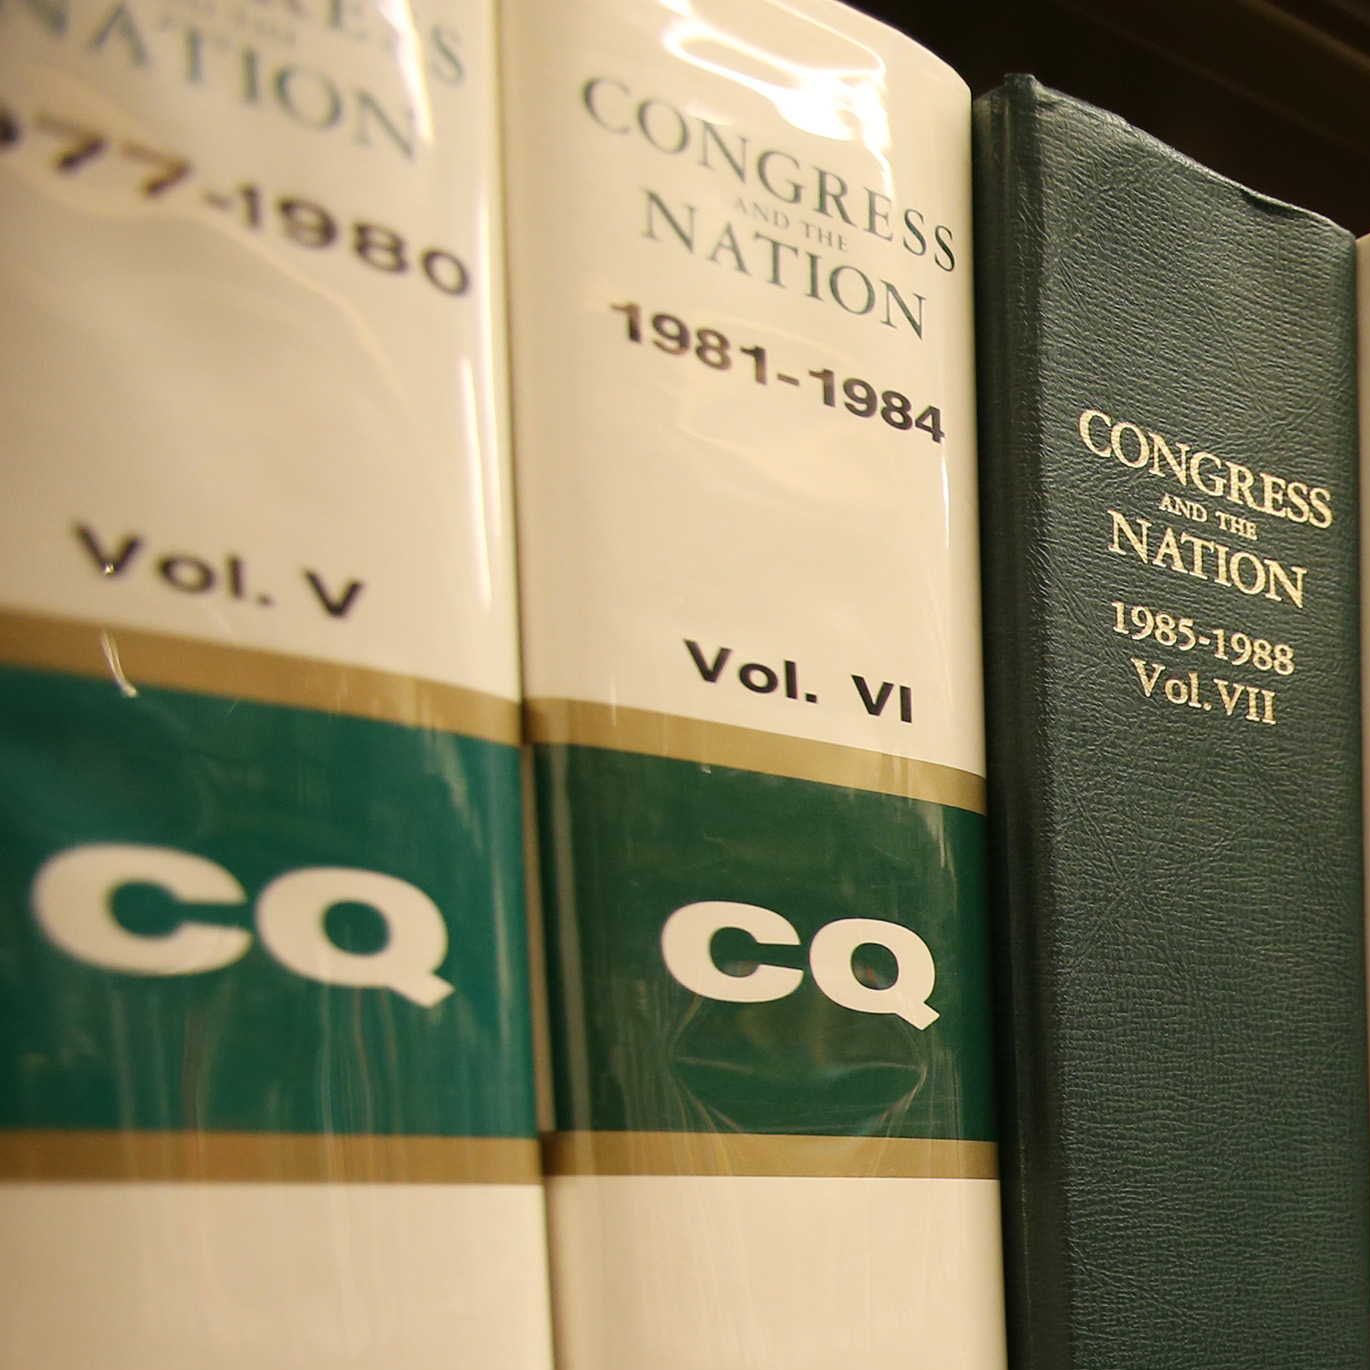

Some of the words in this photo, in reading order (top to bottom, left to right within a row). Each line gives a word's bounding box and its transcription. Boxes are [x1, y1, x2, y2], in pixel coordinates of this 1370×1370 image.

[581, 76, 957, 273] CONGRESS
[736, 196, 790, 230] AND
[800, 220, 849, 252] THE
[641, 188, 926, 341] NATION
[611, 302, 945, 444] 1981-1984
[1078, 408, 1334, 529] CONGRESS
[1159, 492, 1208, 523] AND
[1214, 510, 1258, 541] THE
[72, 520, 274, 607] Vol.
[303, 568, 365, 620] V
[1107, 508, 1308, 609] NATION
[683, 638, 817, 704] Vol.
[850, 674, 913, 724] VI
[1111, 600, 1296, 676] 1985-1988
[31, 843, 455, 1008] CQ
[660, 900, 940, 1032] CQ
